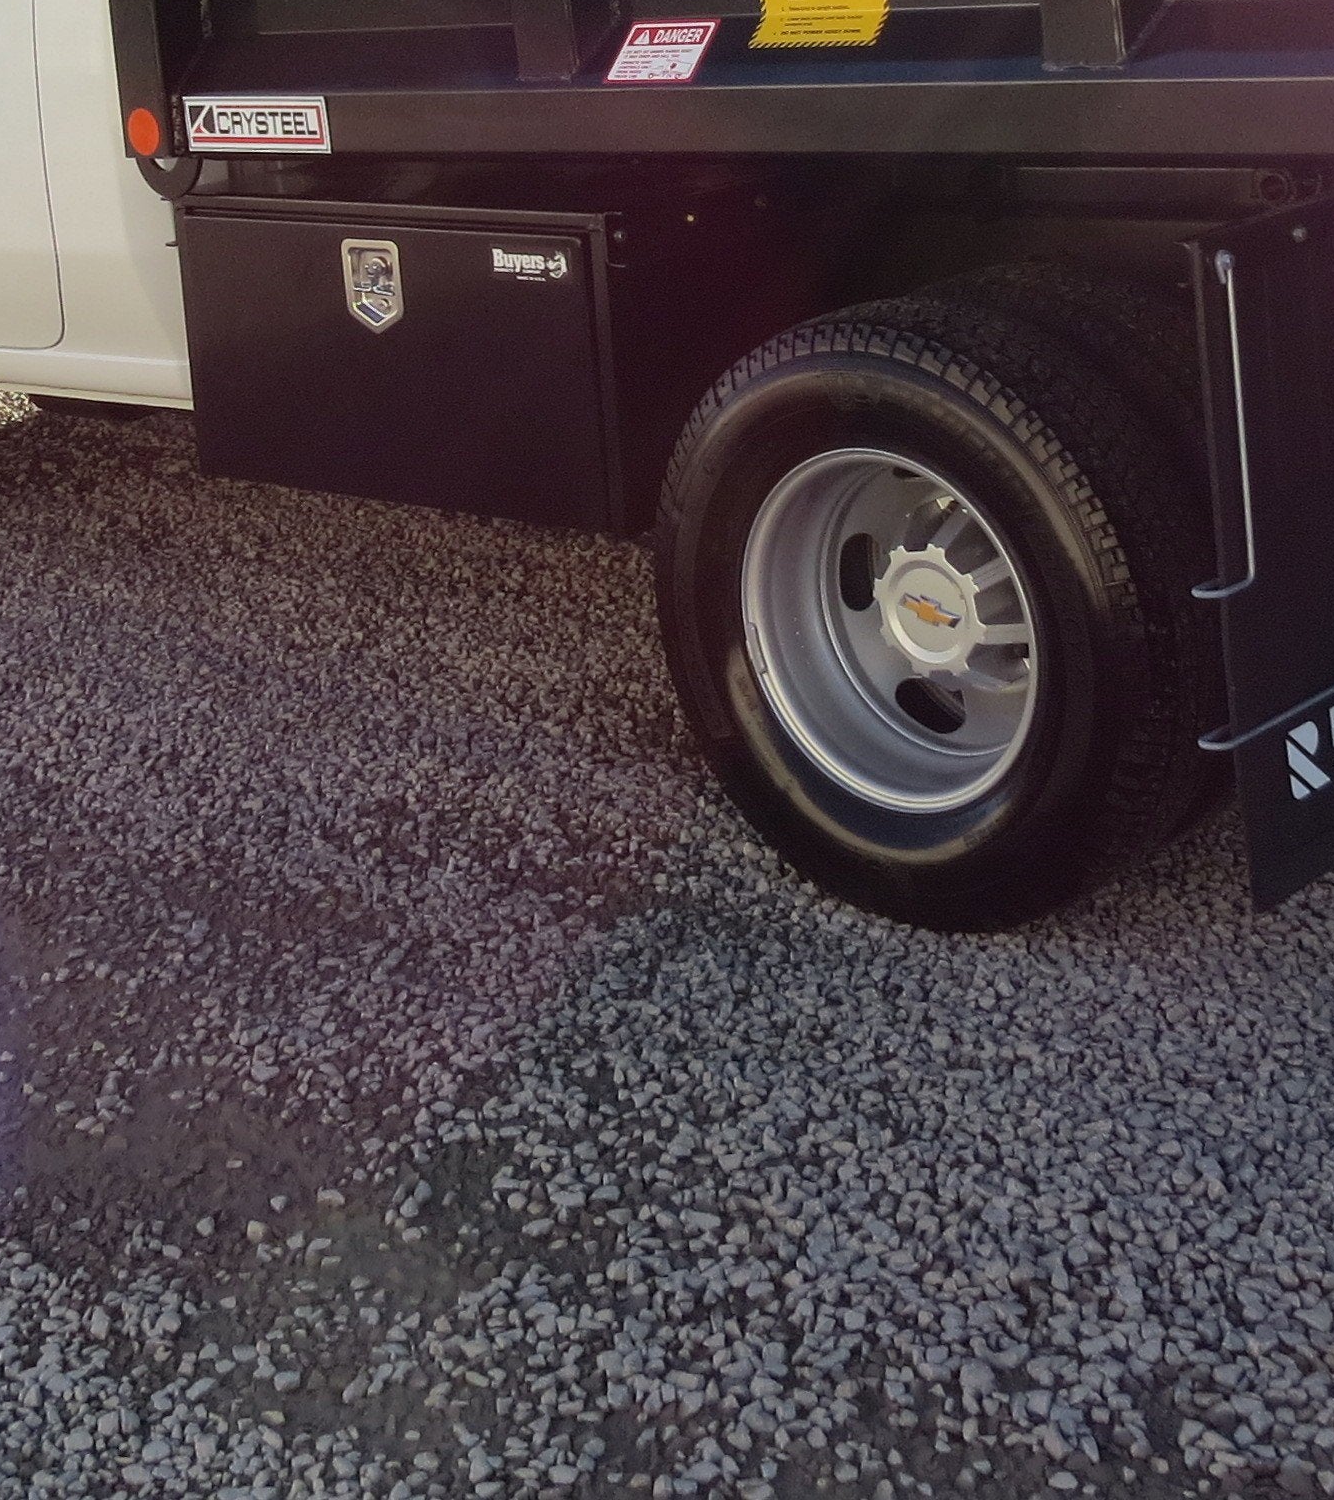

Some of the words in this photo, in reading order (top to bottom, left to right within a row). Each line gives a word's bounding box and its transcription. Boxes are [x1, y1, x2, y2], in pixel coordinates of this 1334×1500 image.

[653, 28, 704, 44] DANGER
[216, 111, 318, 136] CRYSTEEL
[492, 248, 546, 273] Buyers
